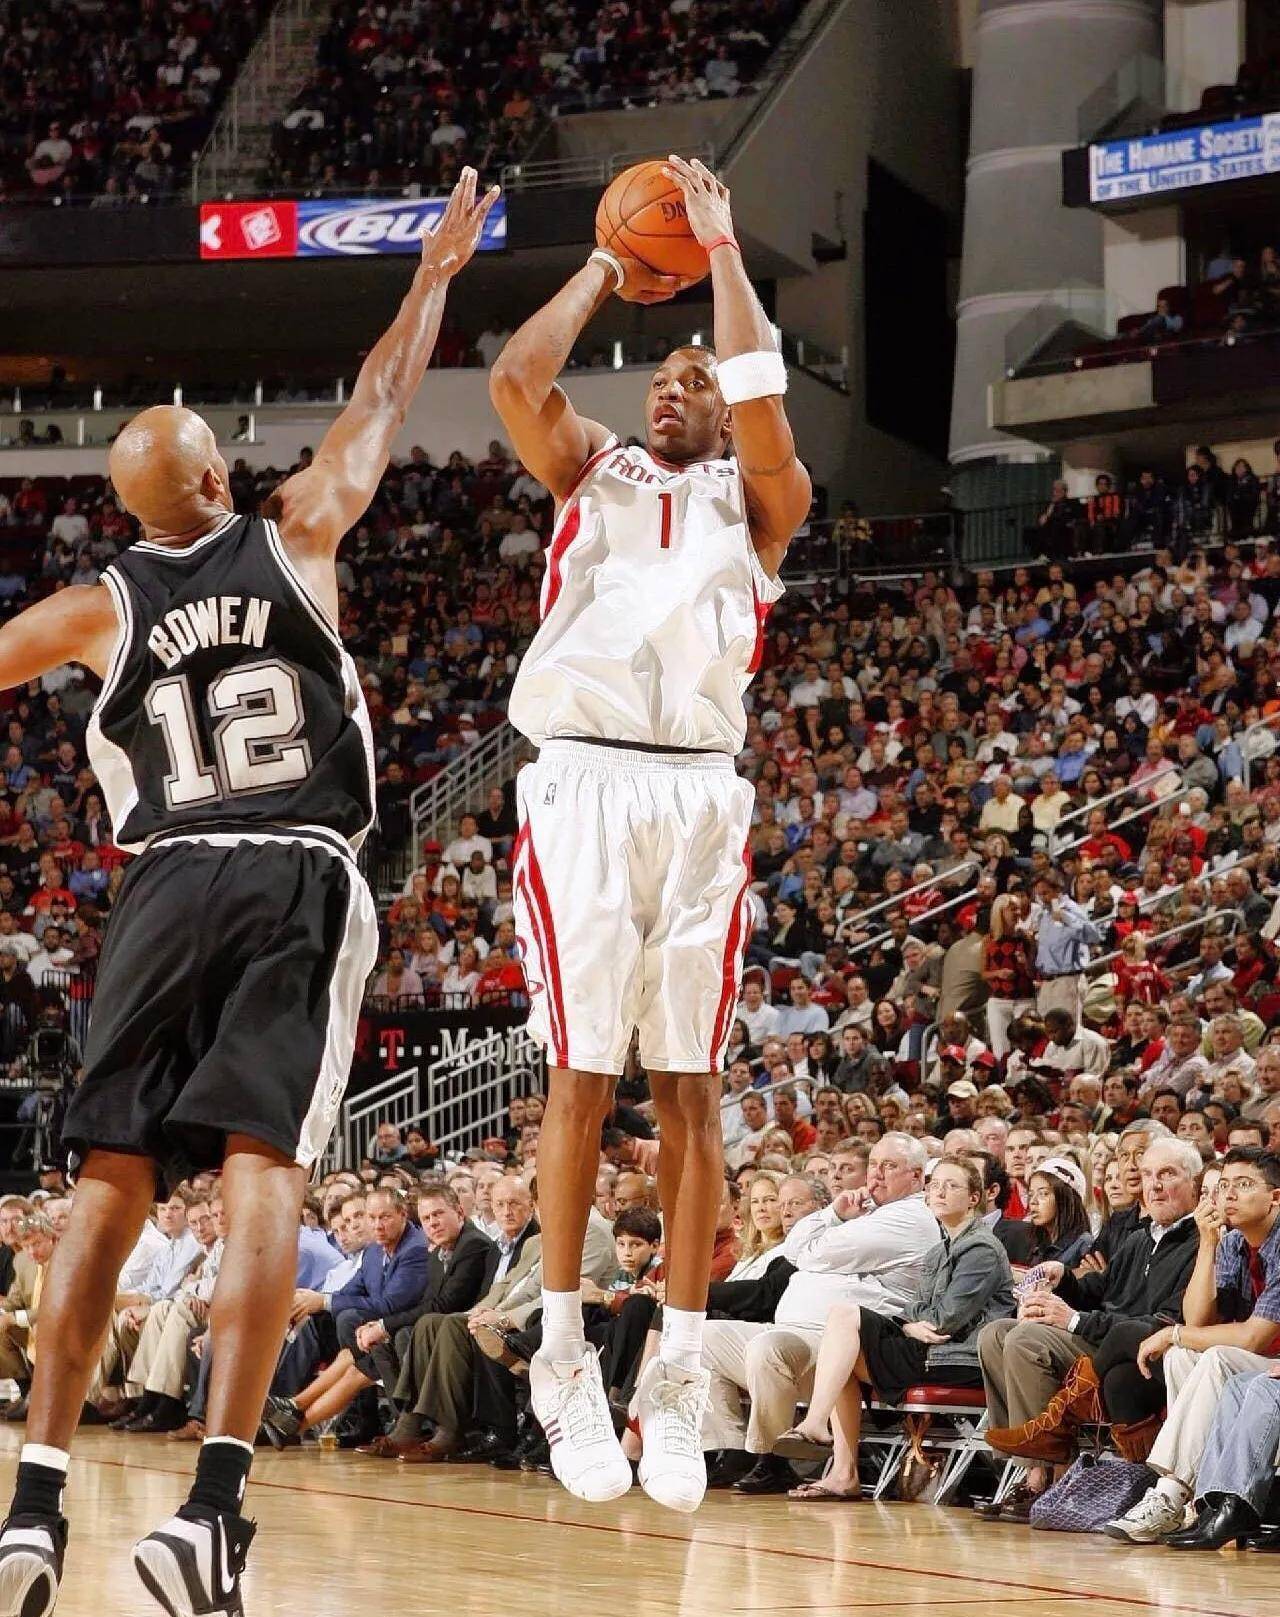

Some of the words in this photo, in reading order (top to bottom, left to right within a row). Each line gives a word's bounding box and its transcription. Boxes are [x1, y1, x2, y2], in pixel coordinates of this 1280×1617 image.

[1096, 146, 1124, 177] THE
[1129, 139, 1195, 171] HUMANE
[1149, 166, 1201, 189] UNITED
[338, 212, 446, 243] BU
[658, 493, 671, 548] 1
[147, 596, 272, 670] BOWEN
[143, 658, 313, 812] 12
